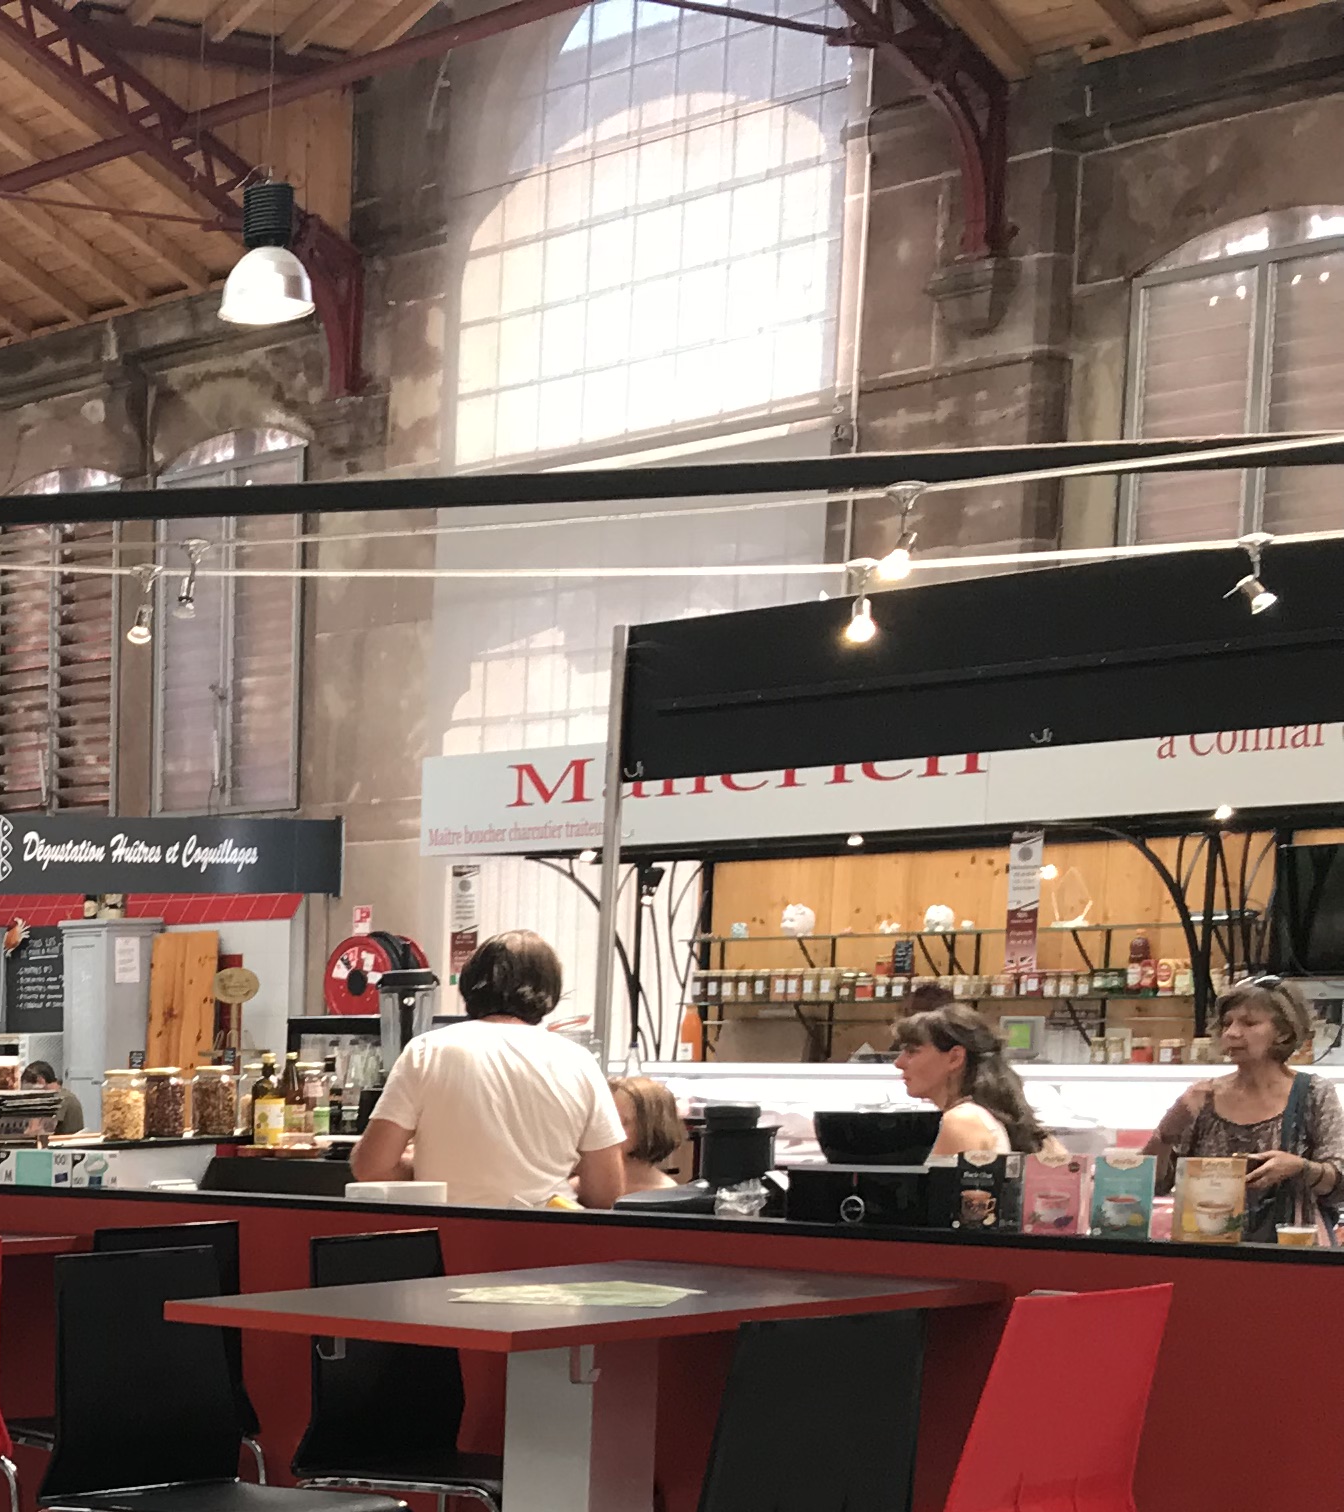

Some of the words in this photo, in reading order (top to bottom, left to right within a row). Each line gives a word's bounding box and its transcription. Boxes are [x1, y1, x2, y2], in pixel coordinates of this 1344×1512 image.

[428, 827, 462, 846] Maître
[464, 824, 506, 844] boucher
[565, 819, 604, 838] traiteu
[23, 831, 105, 872] Dégustation
[109, 833, 161, 865] Huîtres
[165, 842, 180, 864] et
[182, 834, 259, 873] Coquillages
